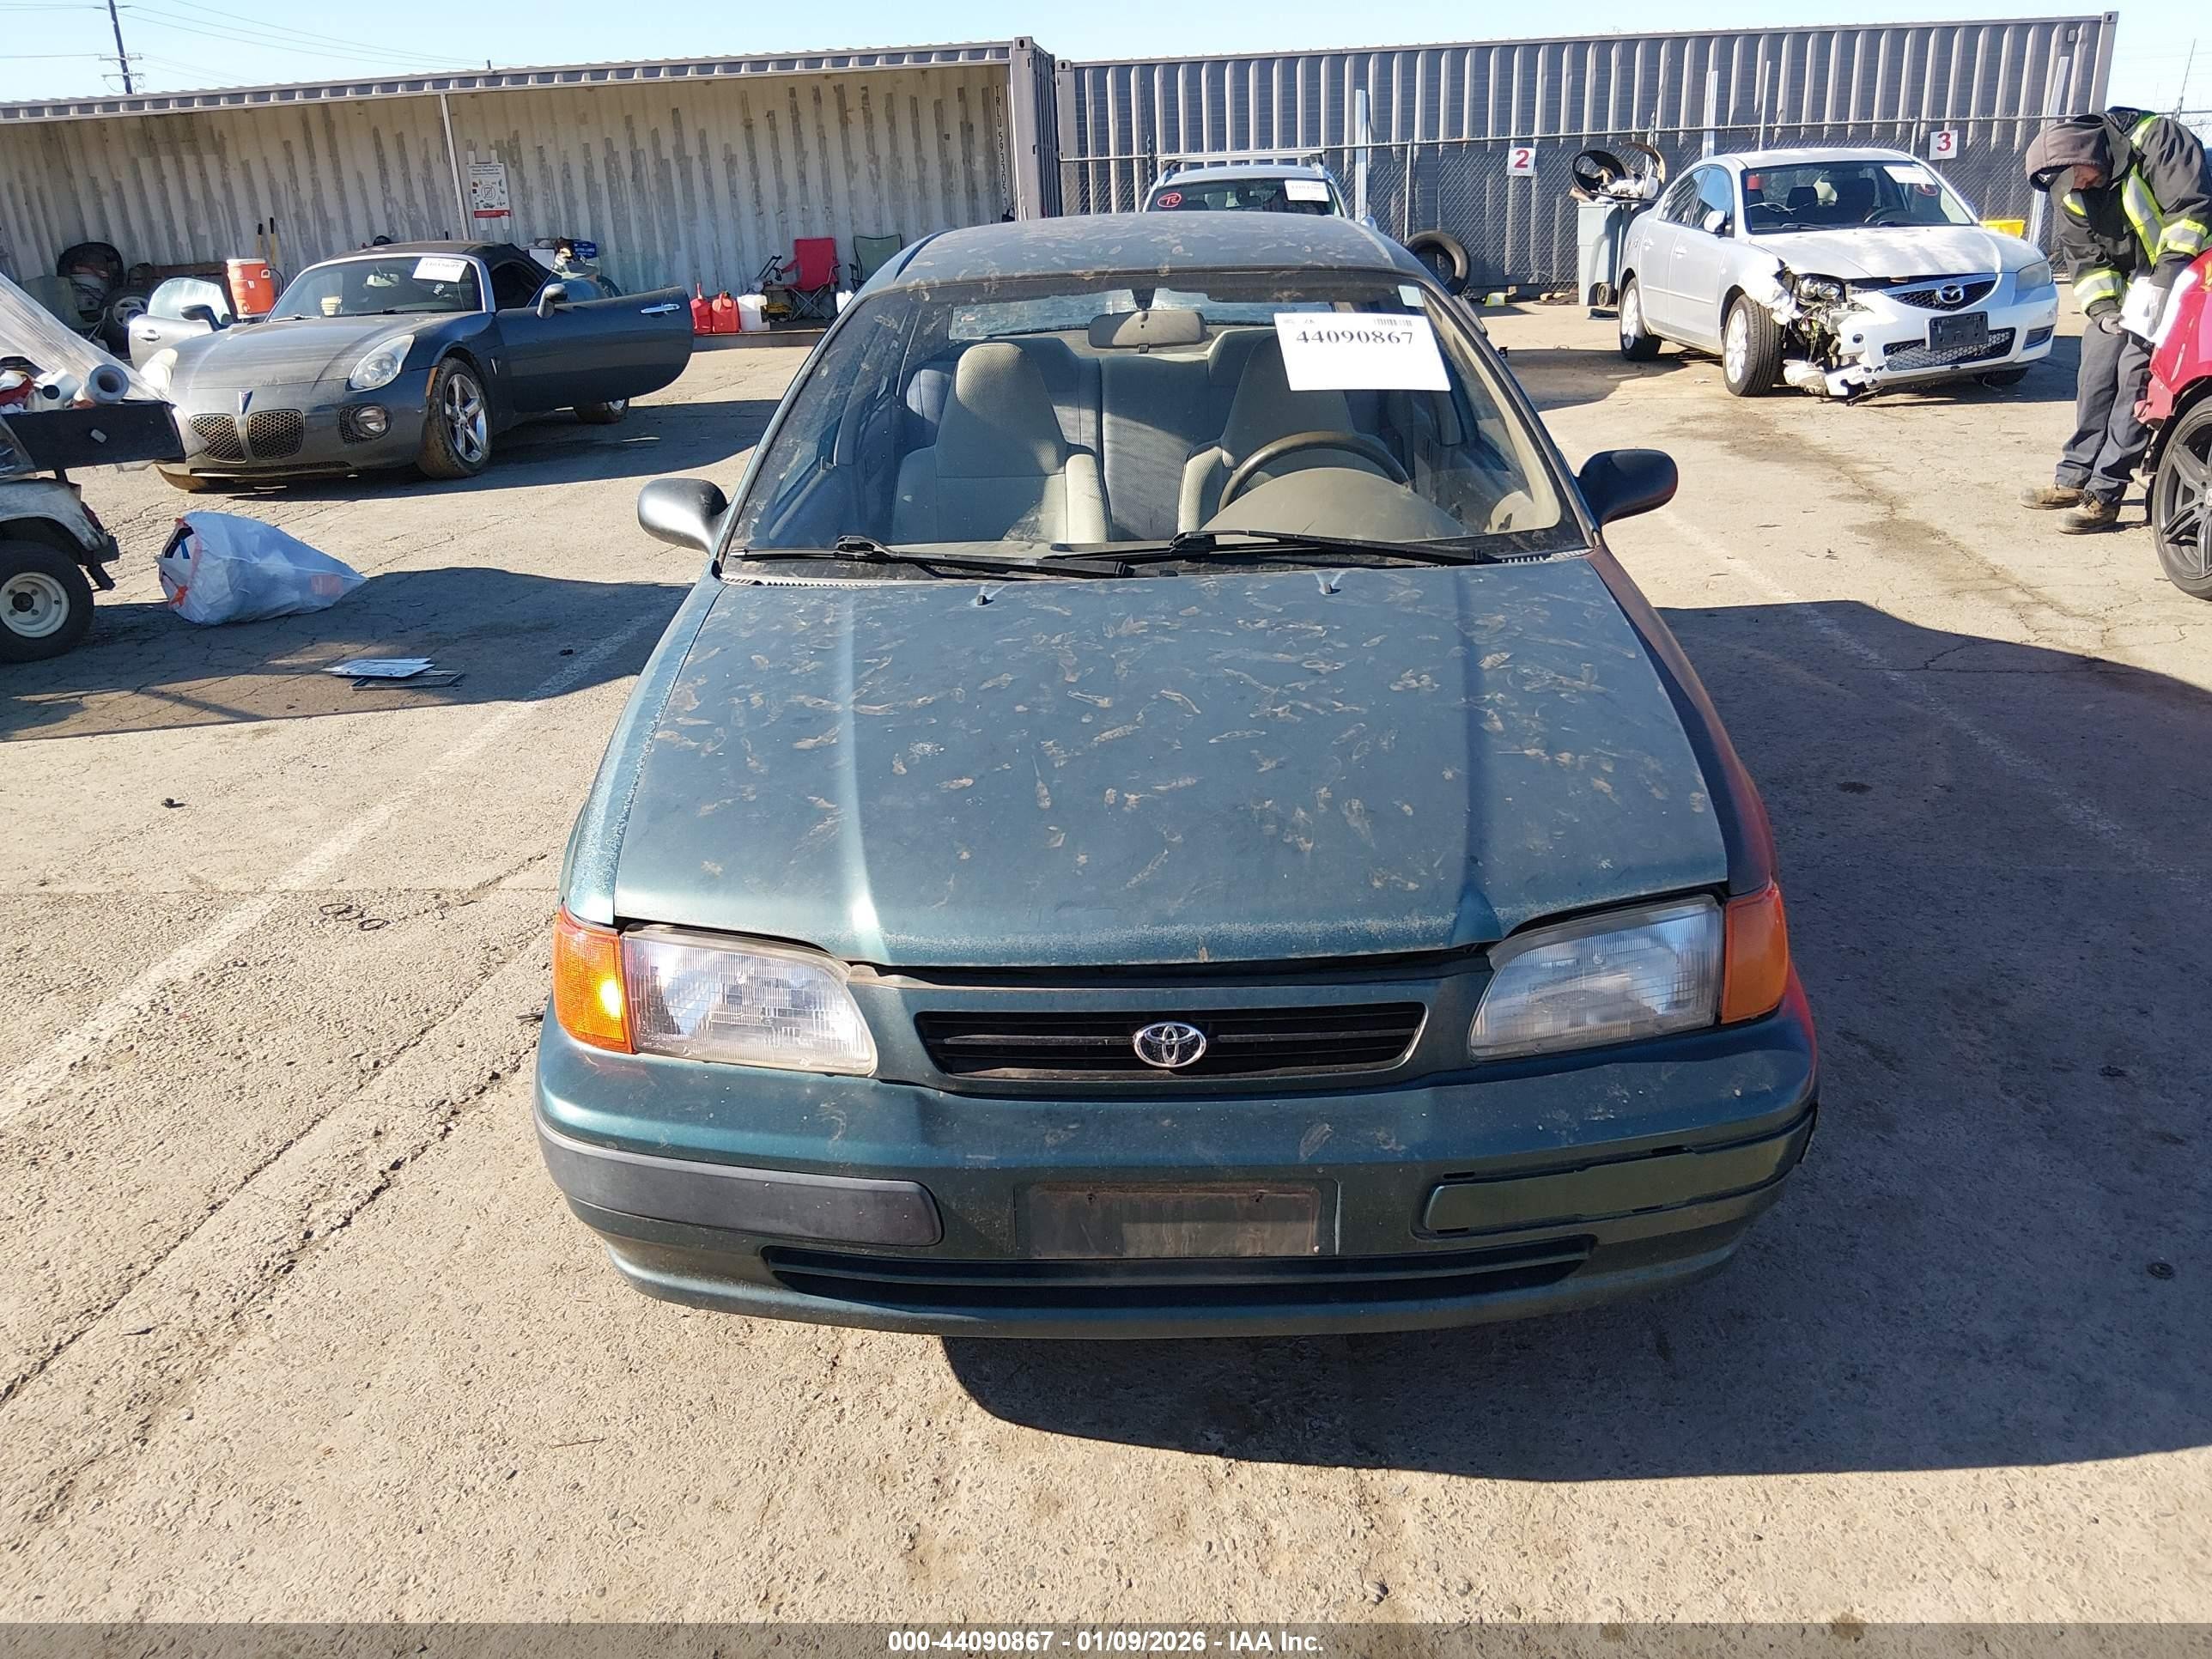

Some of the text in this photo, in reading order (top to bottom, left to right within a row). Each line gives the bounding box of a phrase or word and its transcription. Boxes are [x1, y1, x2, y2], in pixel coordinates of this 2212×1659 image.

[1936, 132, 1951, 151] 3
[1514, 149, 1529, 168] 2
[1296, 330, 1413, 344] 44090867
